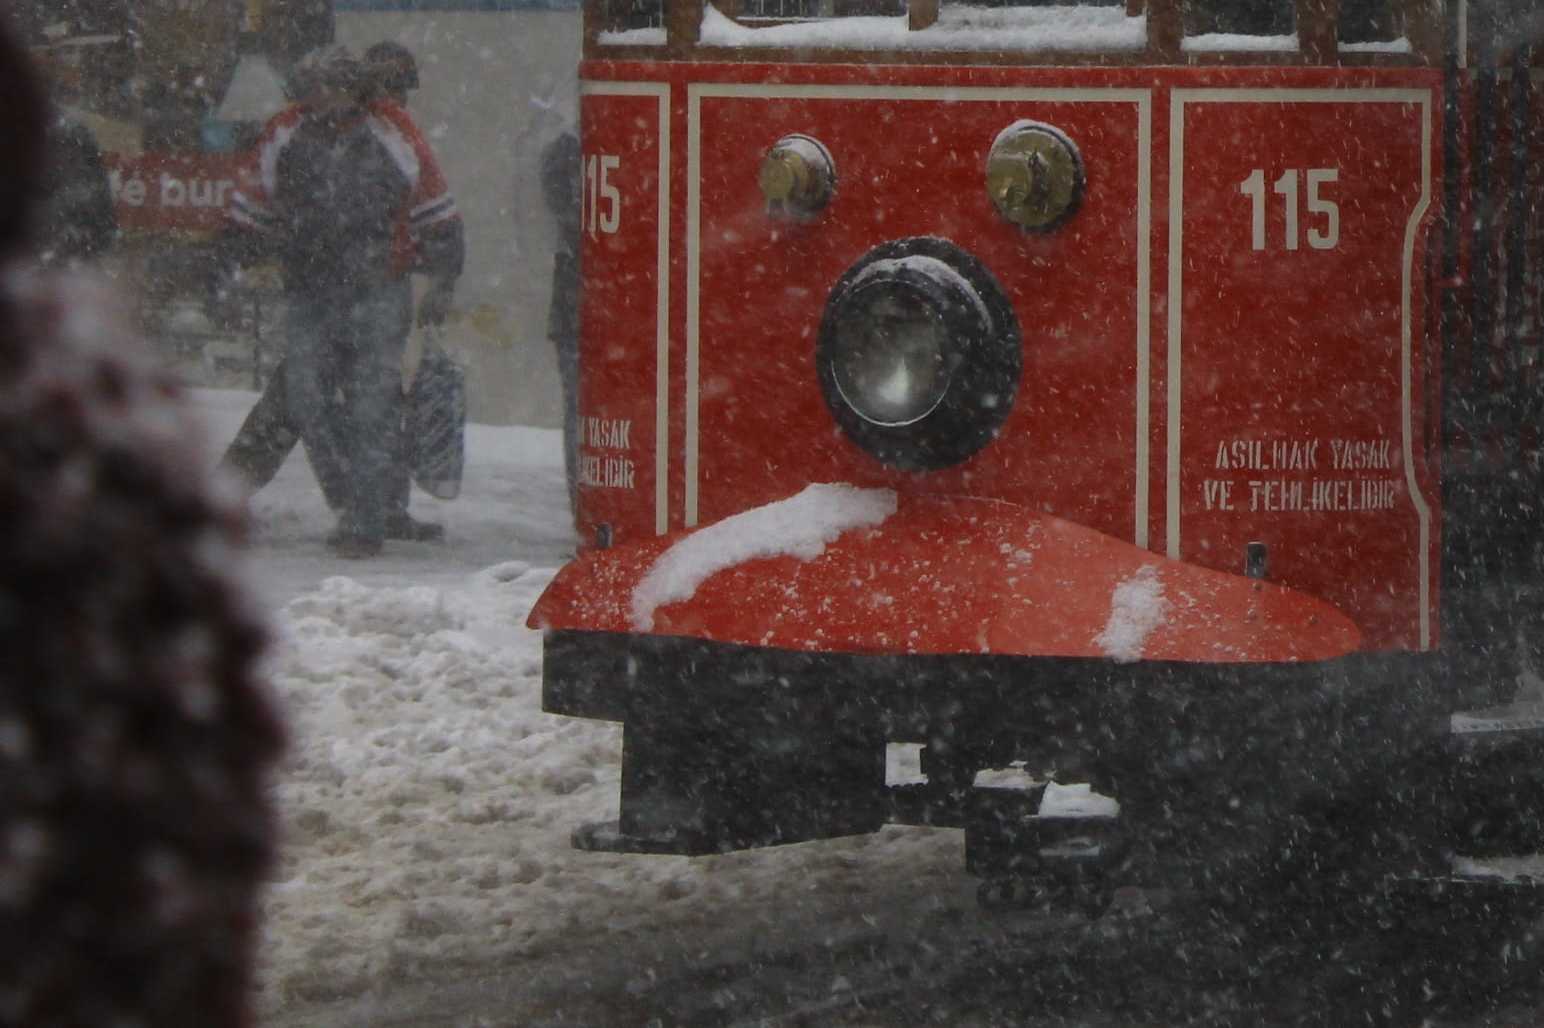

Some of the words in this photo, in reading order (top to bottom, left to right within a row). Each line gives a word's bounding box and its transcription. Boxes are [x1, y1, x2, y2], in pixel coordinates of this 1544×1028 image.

[581, 154, 621, 234] 15
[1240, 169, 1340, 250] 115
[588, 417, 632, 450] YASAK
[1215, 439, 1319, 470] ASILMAK
[1330, 439, 1391, 469] YASAK
[1203, 480, 1235, 510] VE
